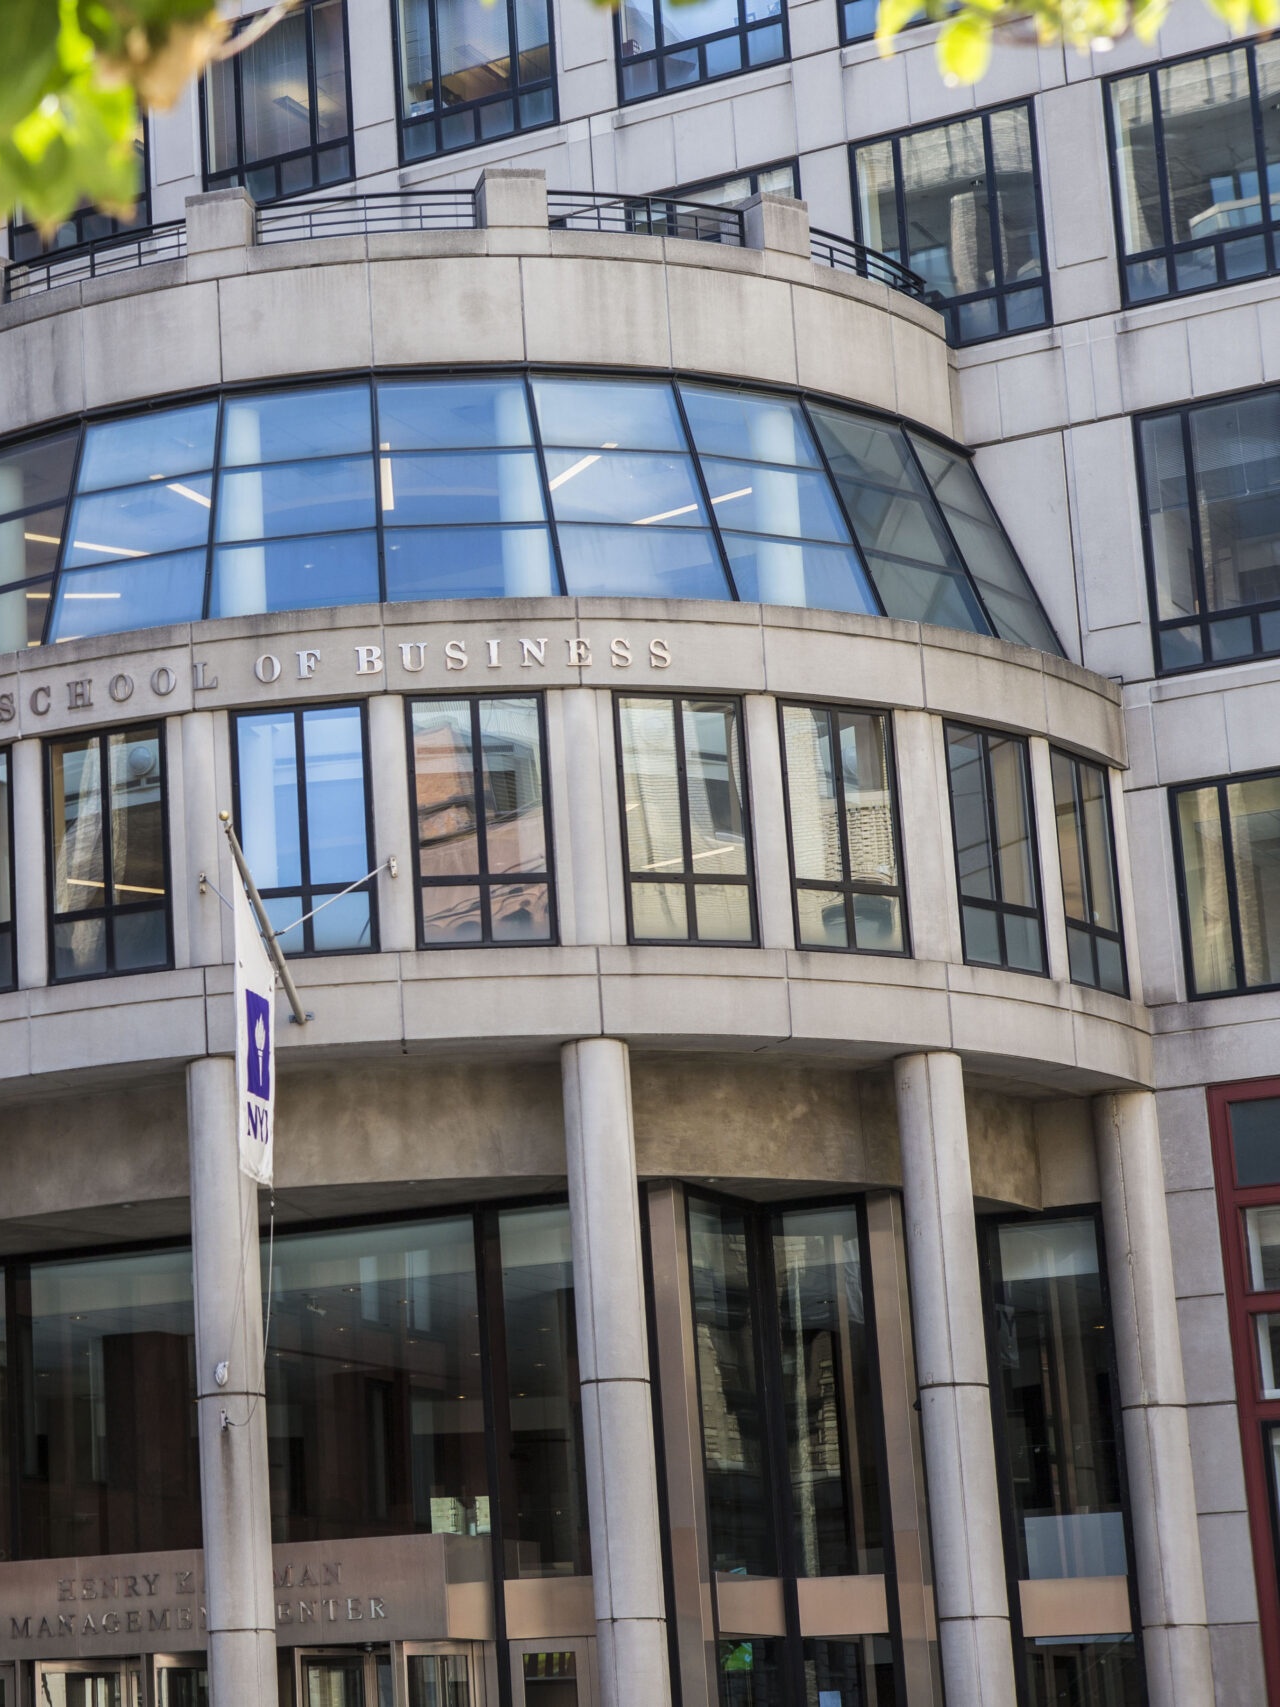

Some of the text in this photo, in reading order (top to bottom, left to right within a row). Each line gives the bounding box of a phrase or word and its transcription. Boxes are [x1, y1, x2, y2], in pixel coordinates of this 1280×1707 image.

[254, 648, 321, 684] OF
[354, 637, 673, 676] BUSINESS
[57, 1573, 160, 1602] HENRY
[276, 1596, 387, 1625] ENTER
